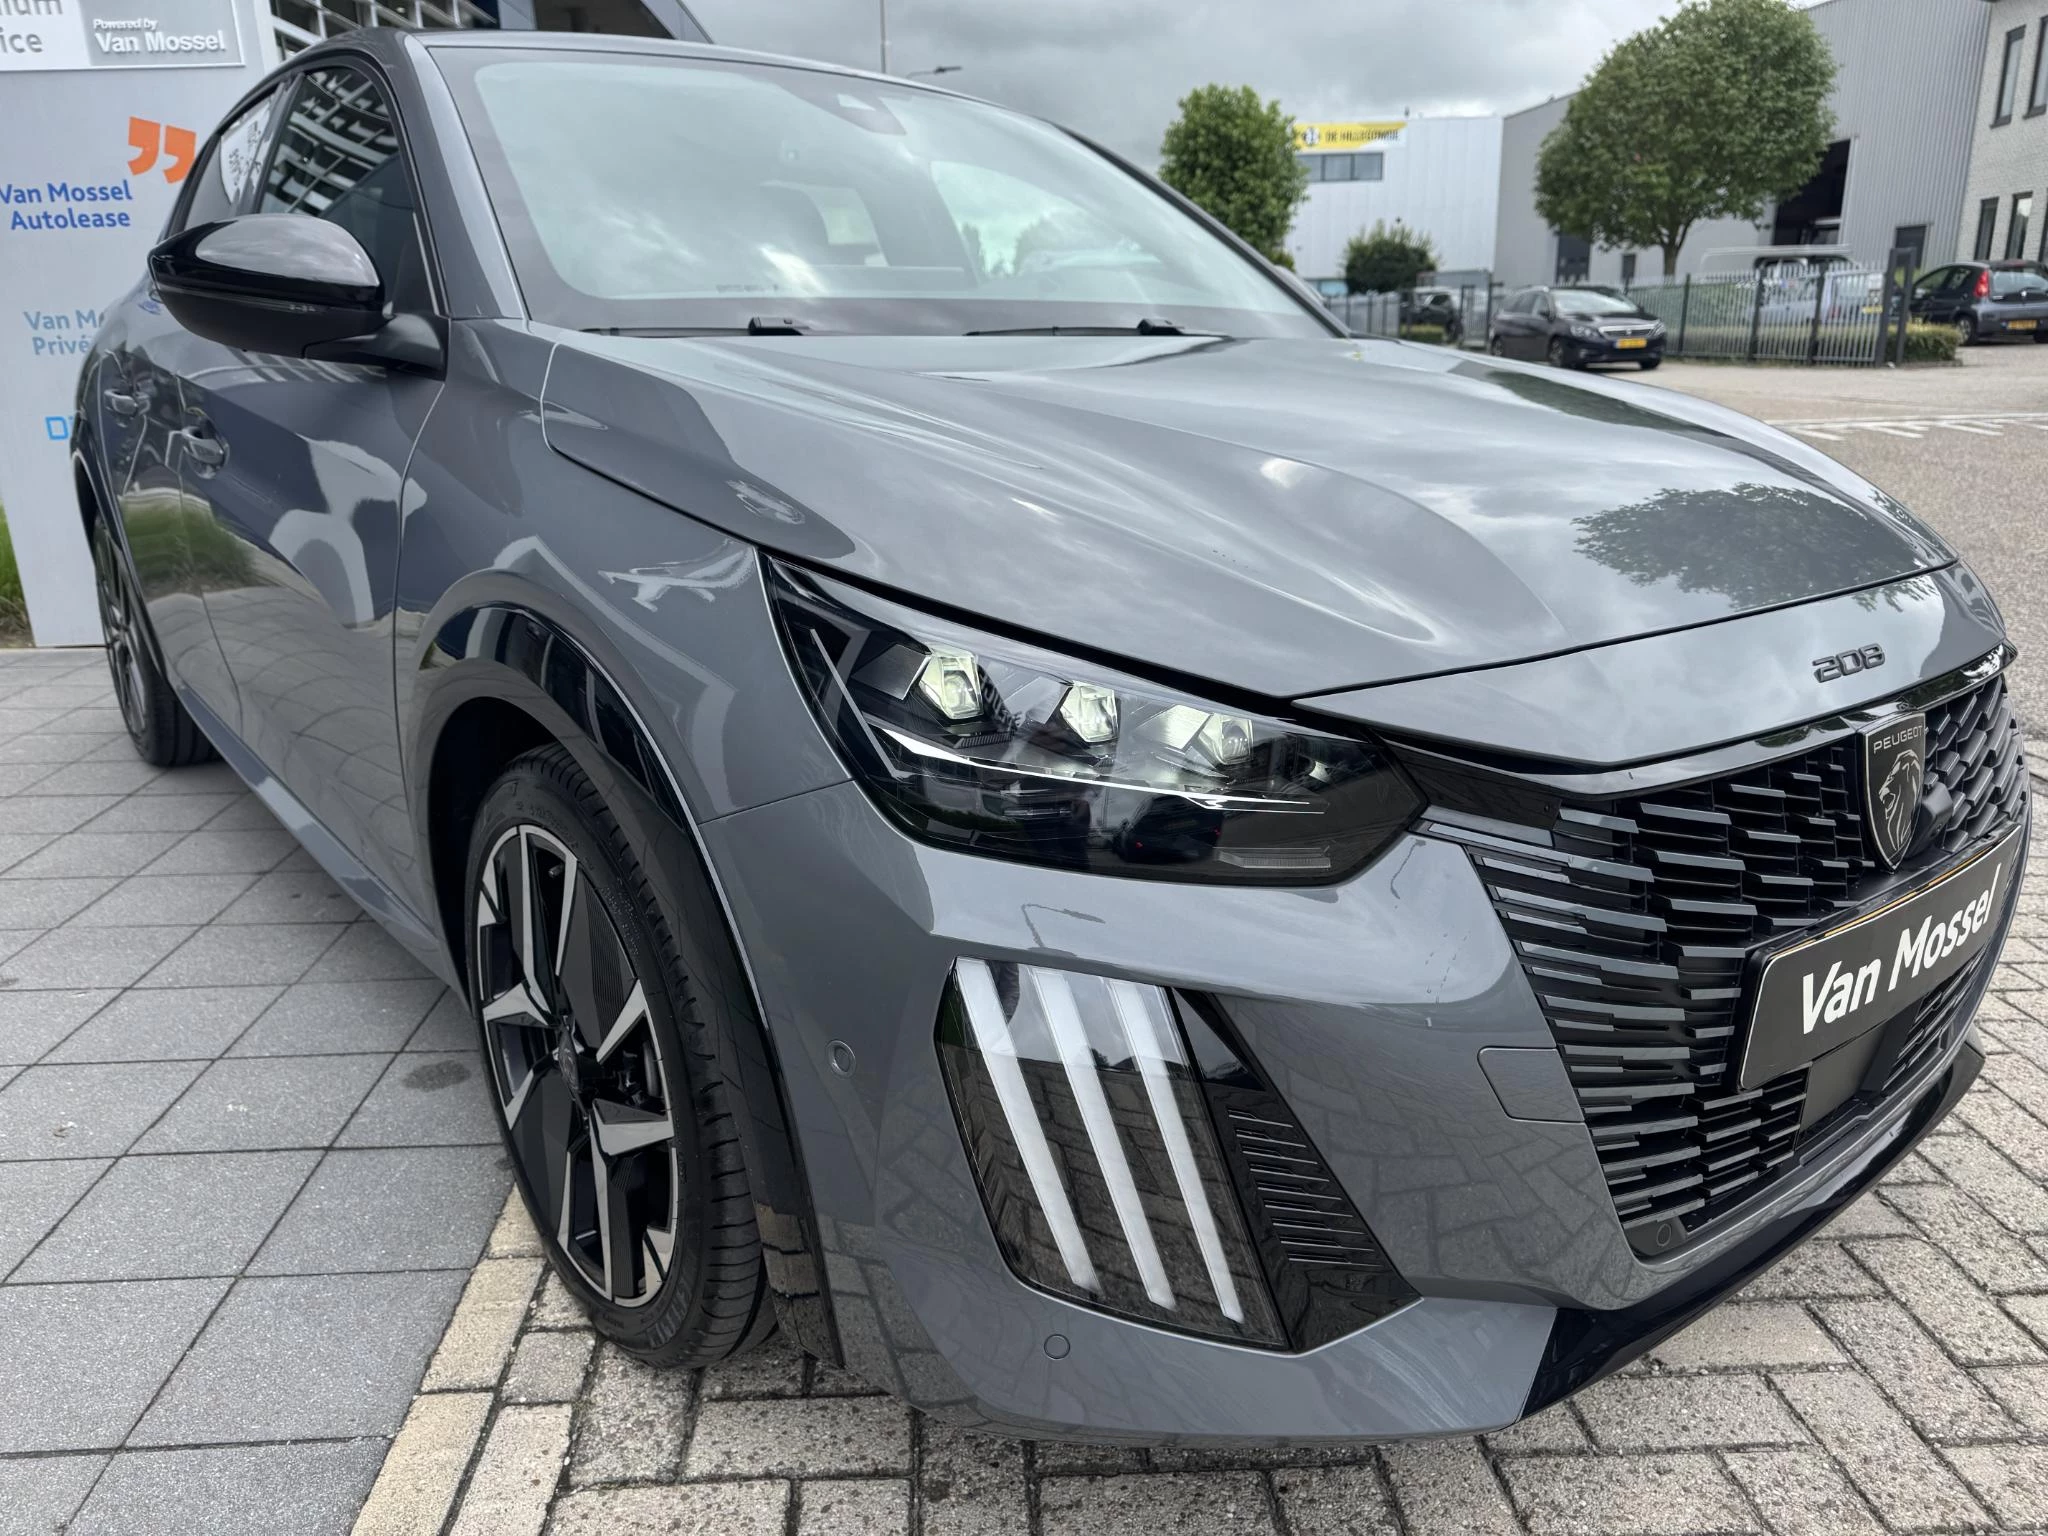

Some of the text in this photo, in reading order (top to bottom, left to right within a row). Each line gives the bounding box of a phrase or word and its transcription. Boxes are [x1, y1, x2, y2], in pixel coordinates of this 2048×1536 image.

[0, 0, 62, 15] ium
[93, 18, 158, 31] Powered by
[95, 30, 226, 53] Van Mossel
[0, 179, 133, 204] Van Mossel
[11, 207, 131, 231] Autolease
[23, 311, 70, 330] Van
[1812, 643, 1886, 683] 208
[1873, 725, 1923, 754] PEUGEOT
[1802, 862, 2002, 1035] Van Mossel
